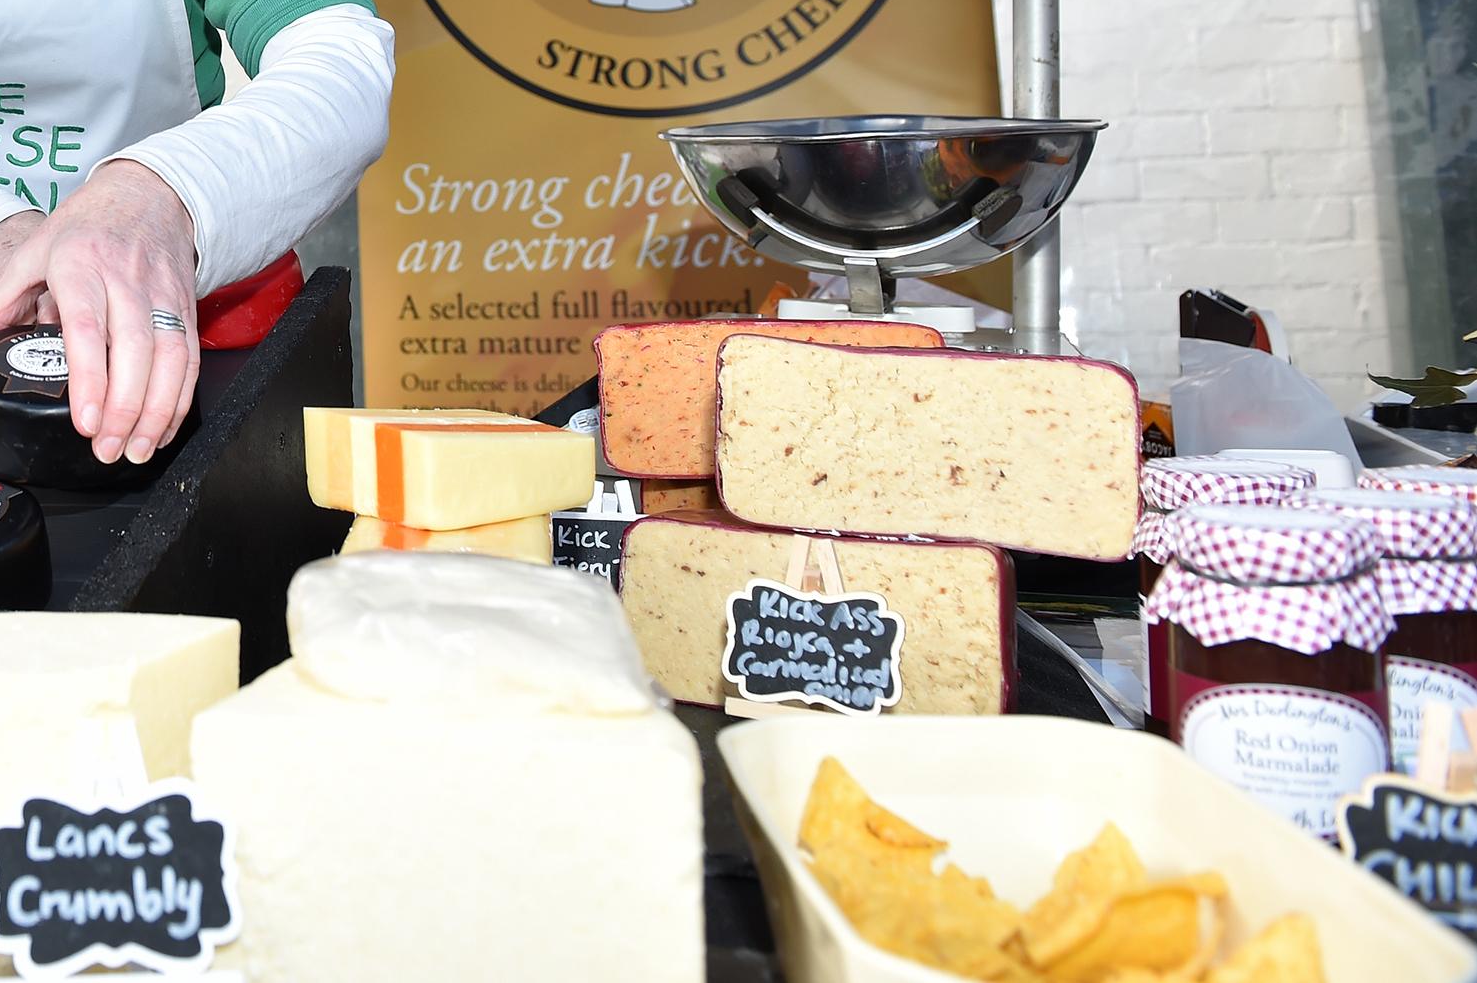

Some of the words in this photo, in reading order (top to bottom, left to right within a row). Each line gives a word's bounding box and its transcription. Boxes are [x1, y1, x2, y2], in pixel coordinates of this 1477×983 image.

[537, 37, 726, 91] STRONG
[396, 163, 570, 229] Strong
[397, 238, 463, 274] an
[483, 231, 616, 272] extra
[399, 296, 419, 319] A
[430, 292, 539, 320] selected
[552, 289, 599, 319] full
[612, 288, 752, 320] flavoured
[10, 332, 49, 343] BLACK
[400, 334, 466, 355] extra
[479, 332, 581, 355] mature
[401, 372, 441, 393] Our
[445, 373, 508, 393] cheese
[513, 374, 528, 393] is
[1140, 439, 1173, 456] JACOB
[558, 524, 610, 550] Kick
[1254, 699, 1353, 732] Darlington's
[1236, 728, 1273, 751] Red
[1279, 735, 1338, 755] Onion
[1235, 750, 1340, 774] Marmalade
[26, 816, 174, 861] Lancs
[7, 866, 203, 940] Crumbly
